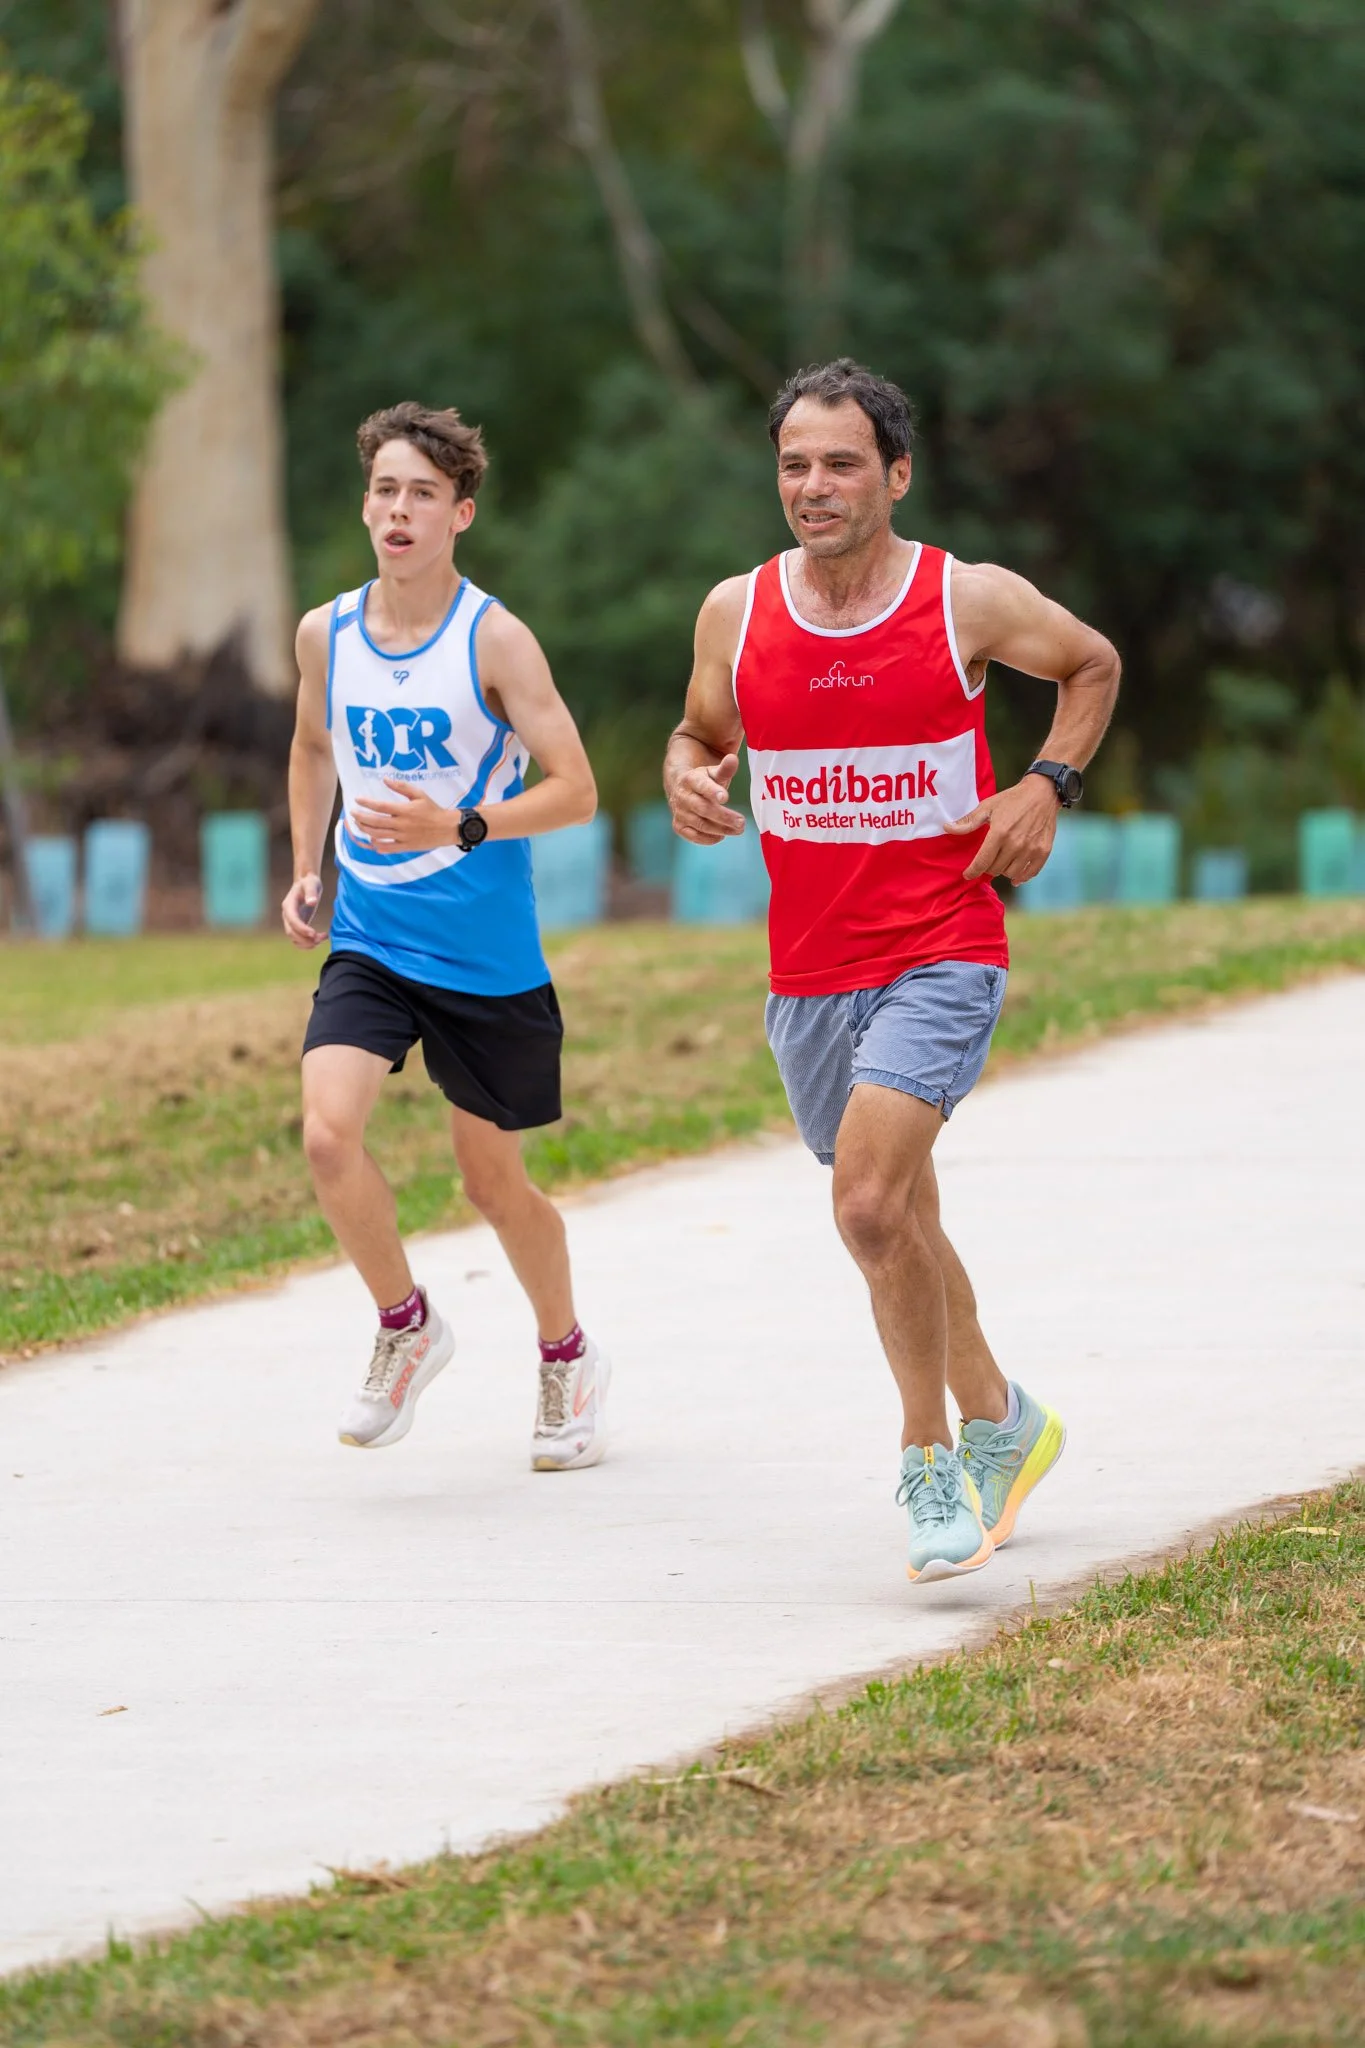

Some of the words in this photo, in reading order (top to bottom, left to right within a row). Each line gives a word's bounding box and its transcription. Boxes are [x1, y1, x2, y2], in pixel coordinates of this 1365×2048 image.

[809, 669, 874, 692] parkrun
[346, 705, 459, 771] DCR
[761, 760, 938, 805] medibank
[782, 809, 802, 828] For
[805, 812, 856, 829] Better
[859, 808, 915, 829] Health
